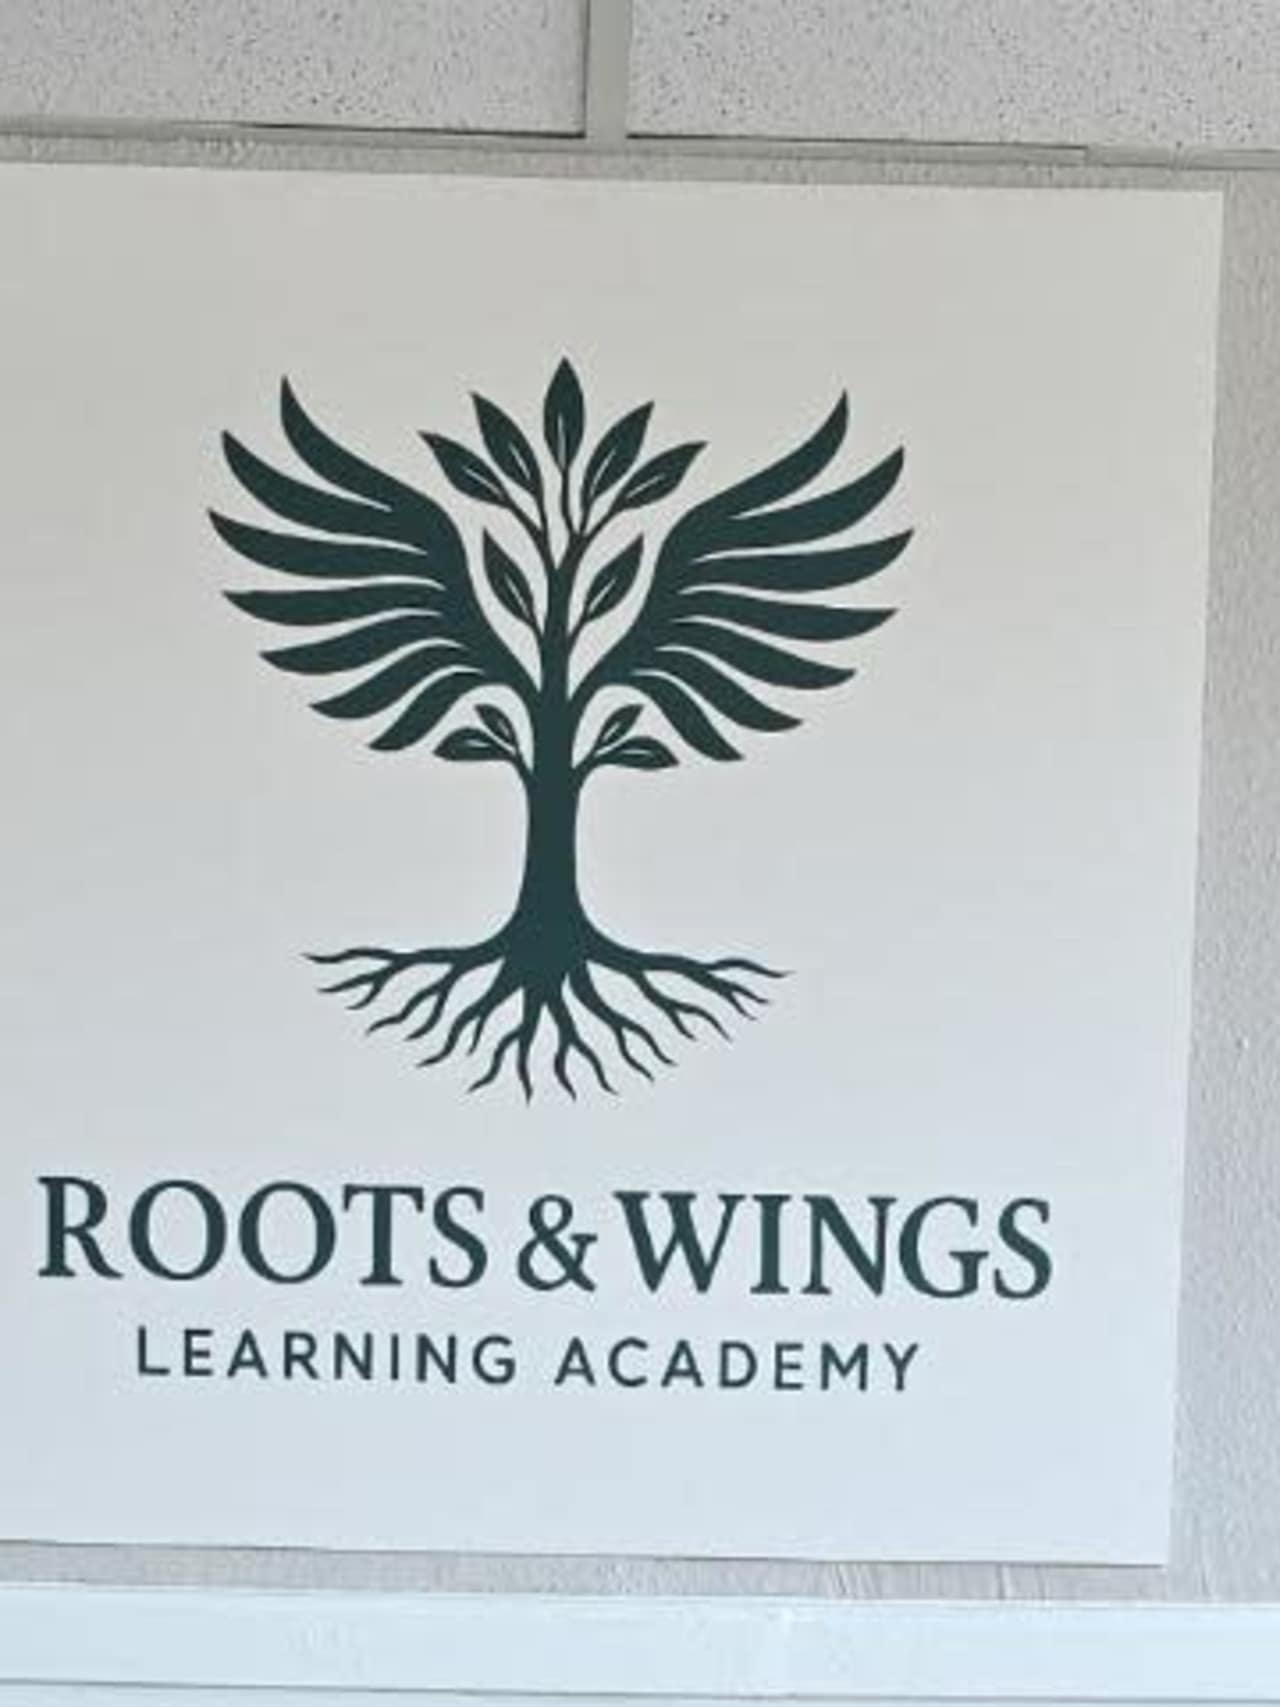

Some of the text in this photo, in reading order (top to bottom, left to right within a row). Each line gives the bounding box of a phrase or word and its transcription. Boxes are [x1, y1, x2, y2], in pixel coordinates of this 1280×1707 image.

[37, 1175, 1054, 1301] ROOTS & WINGS
[136, 1325, 921, 1392] LEARNING ACADEMY
